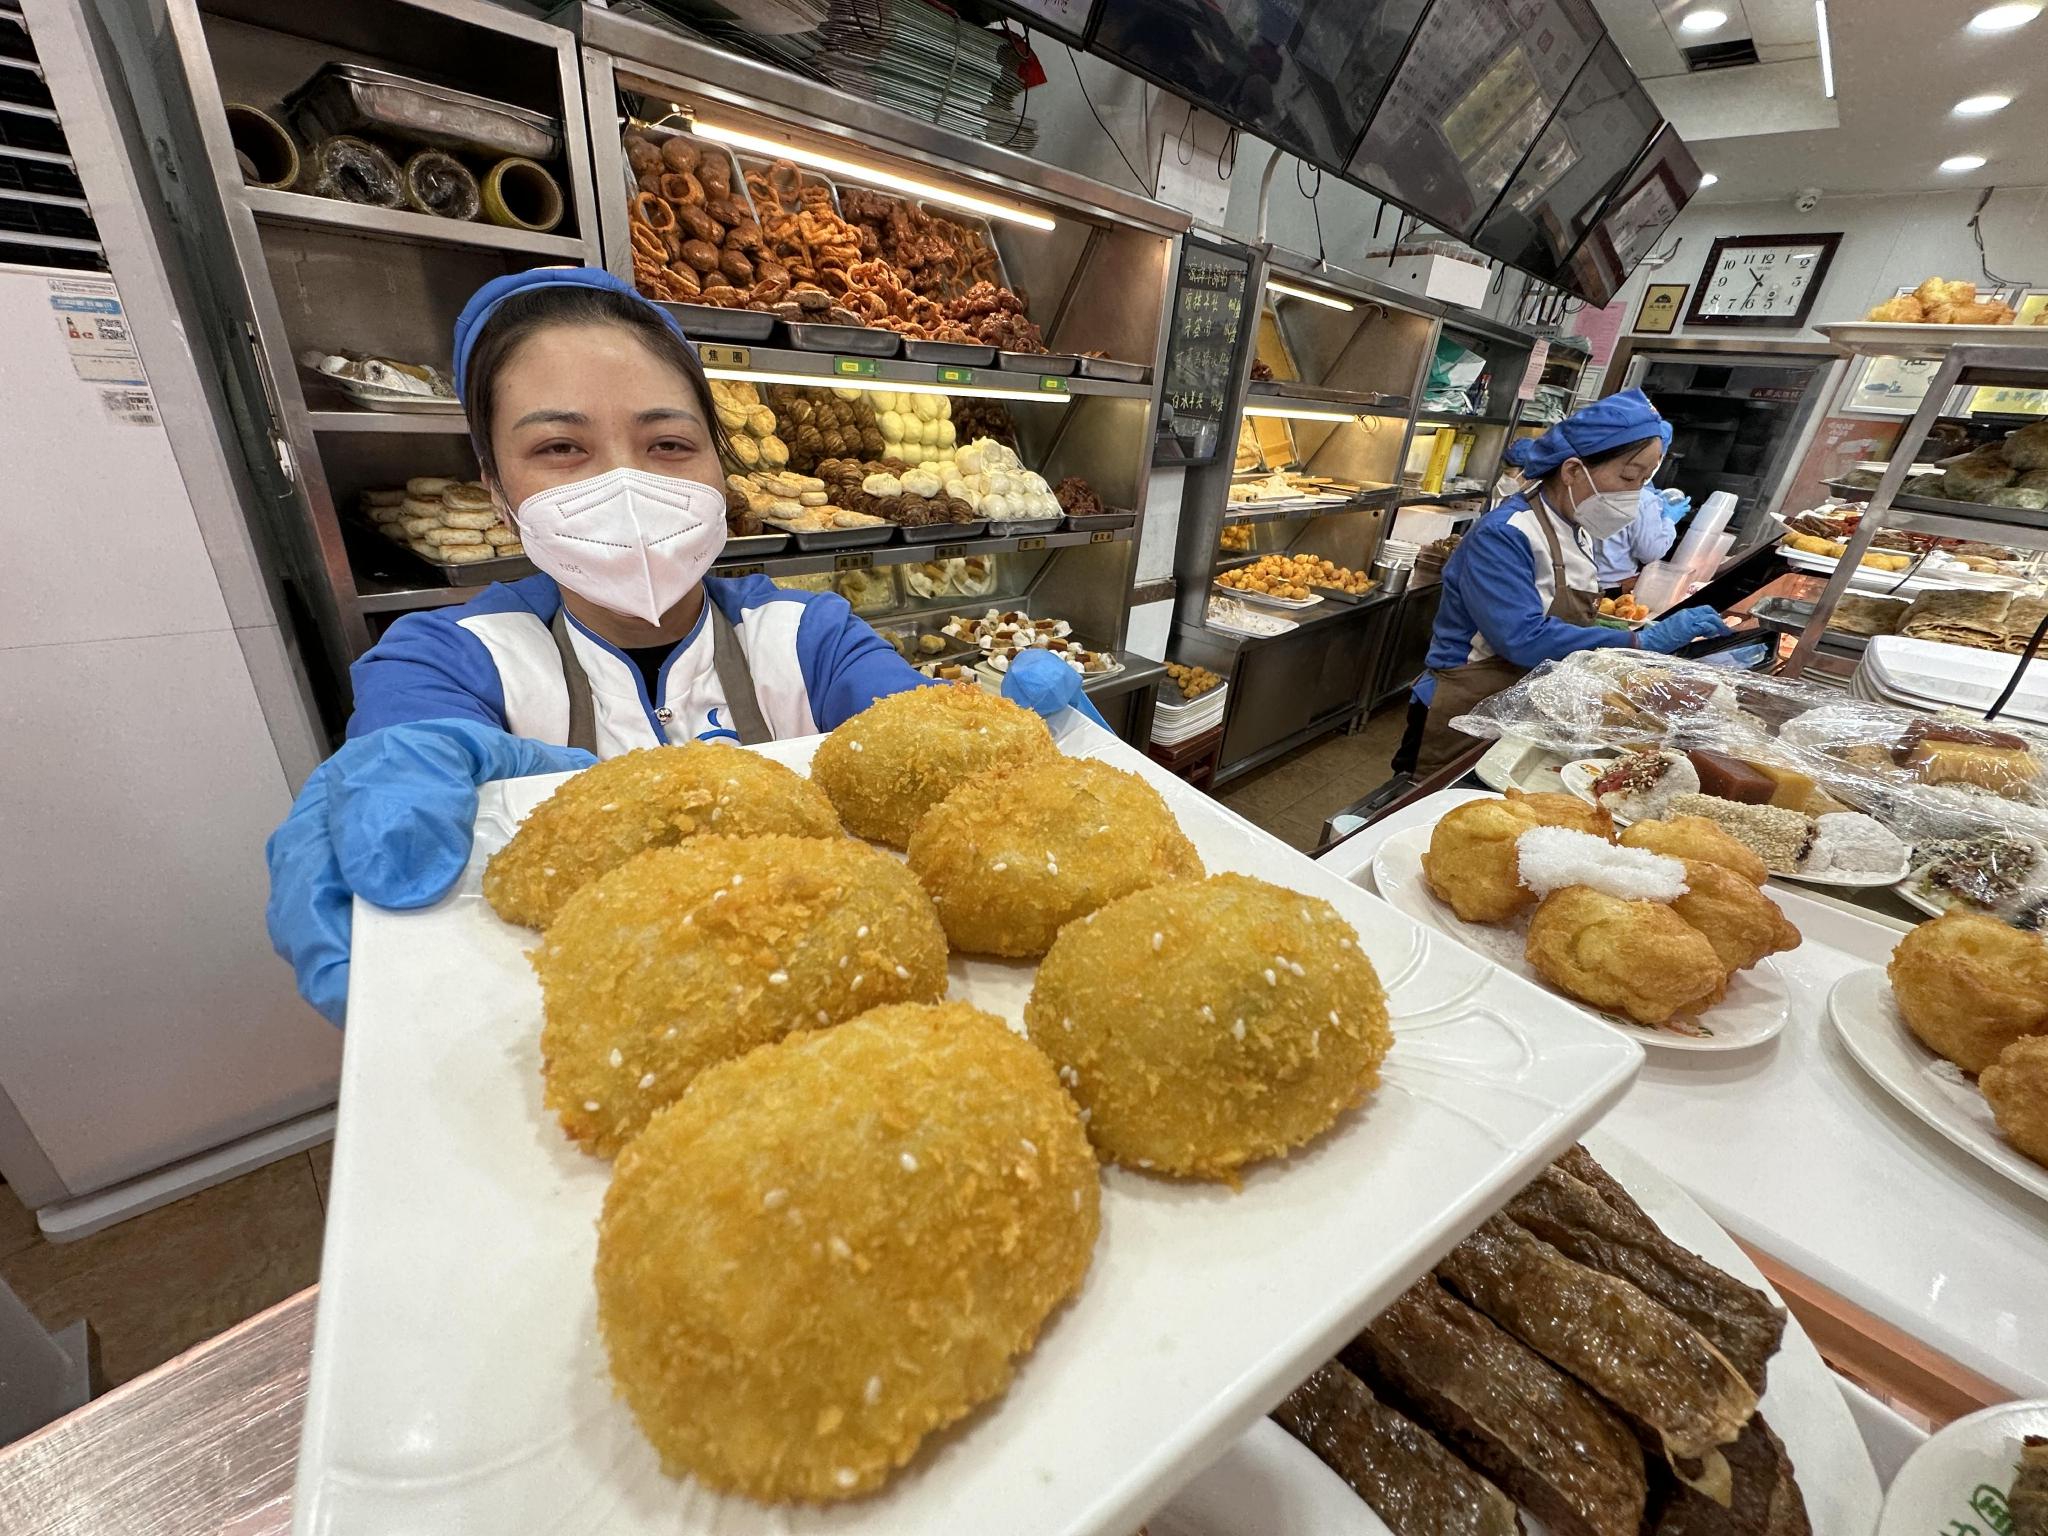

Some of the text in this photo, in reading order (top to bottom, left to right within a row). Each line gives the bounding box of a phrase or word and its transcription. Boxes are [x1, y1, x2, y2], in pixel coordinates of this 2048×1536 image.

[1743, 254, 1756, 264] 11
[1761, 254, 1776, 264] 12
[1784, 254, 1791, 264] 1
[1799, 258, 1810, 269] 2
[1723, 260, 1736, 270] 10
[1719, 277, 1728, 287] 9
[1791, 276, 1802, 287] 3
[1710, 294, 1720, 304] 8
[1727, 298, 1737, 309] 7
[1744, 299, 1754, 309] 6
[1763, 298, 1774, 309] 5
